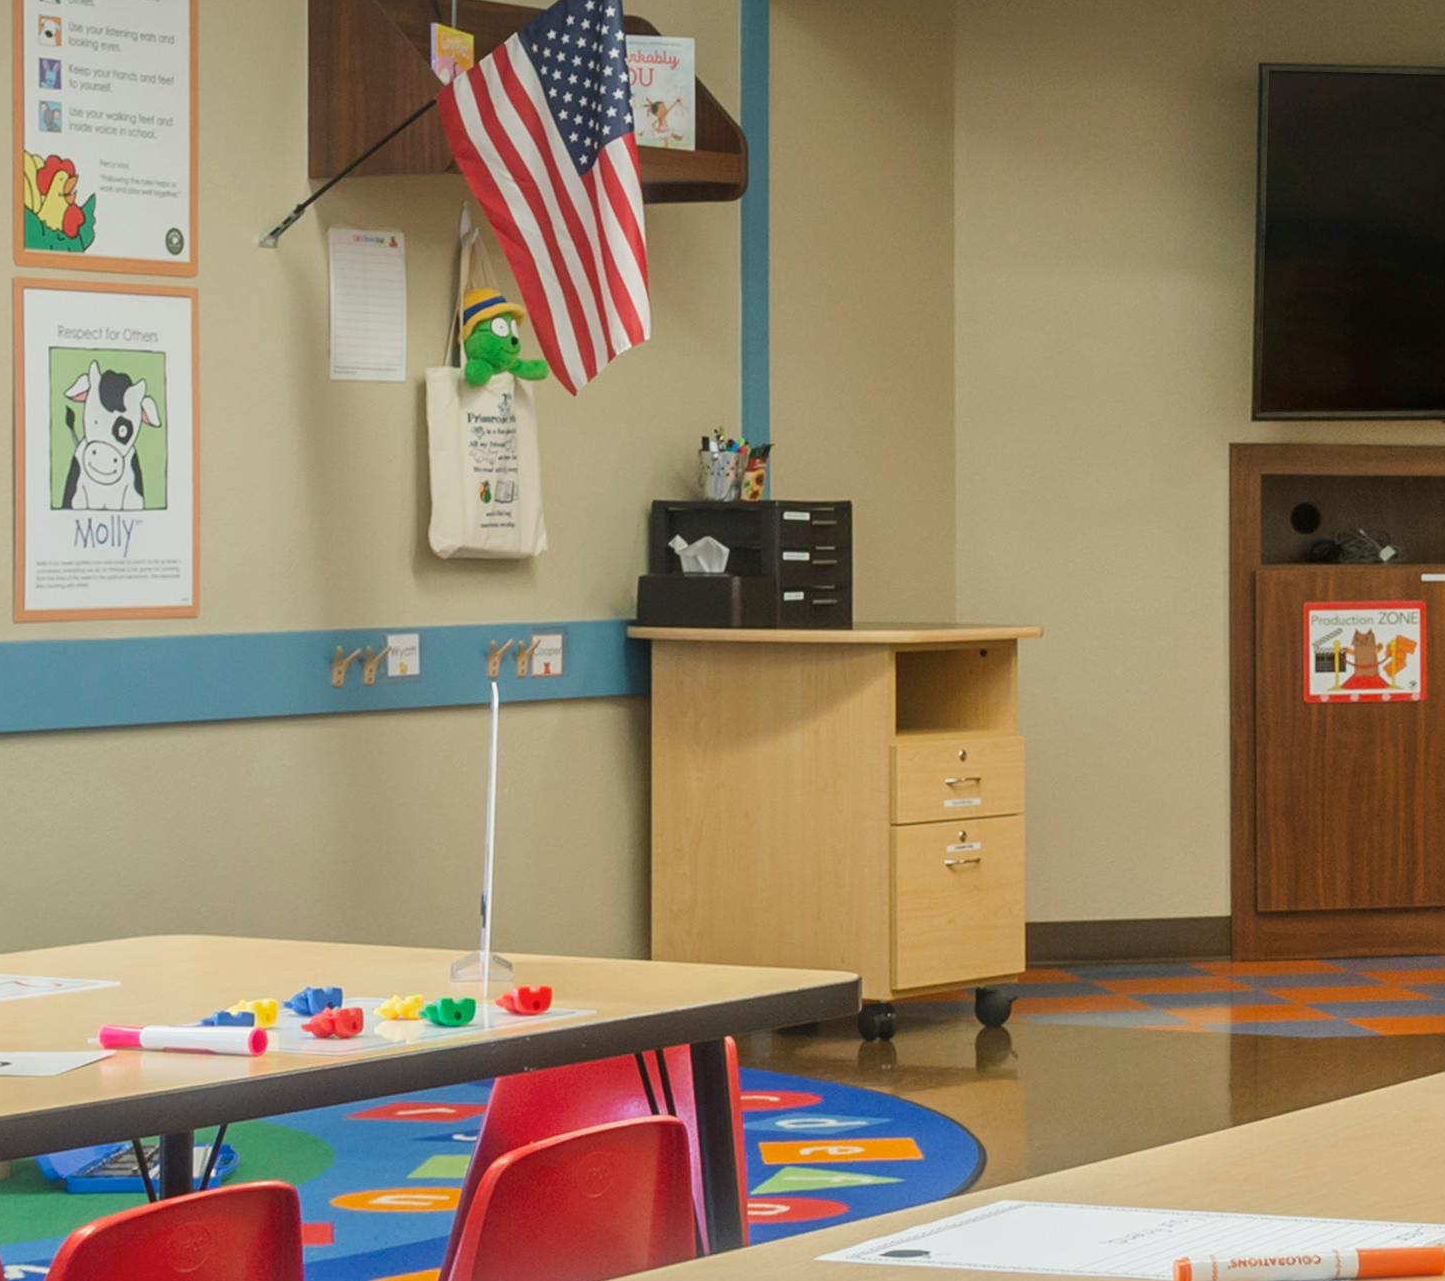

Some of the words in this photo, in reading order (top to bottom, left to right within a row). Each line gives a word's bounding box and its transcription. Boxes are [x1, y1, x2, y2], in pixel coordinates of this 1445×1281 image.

[57, 323, 101, 342] Respect
[103, 326, 121, 342] for
[121, 328, 160, 344] Others
[73, 514, 135, 558] Molly
[1311, 614, 1374, 626] Production
[1378, 610, 1419, 626] ZONE
[1228, 1254, 1322, 1270] COLORATIONS
